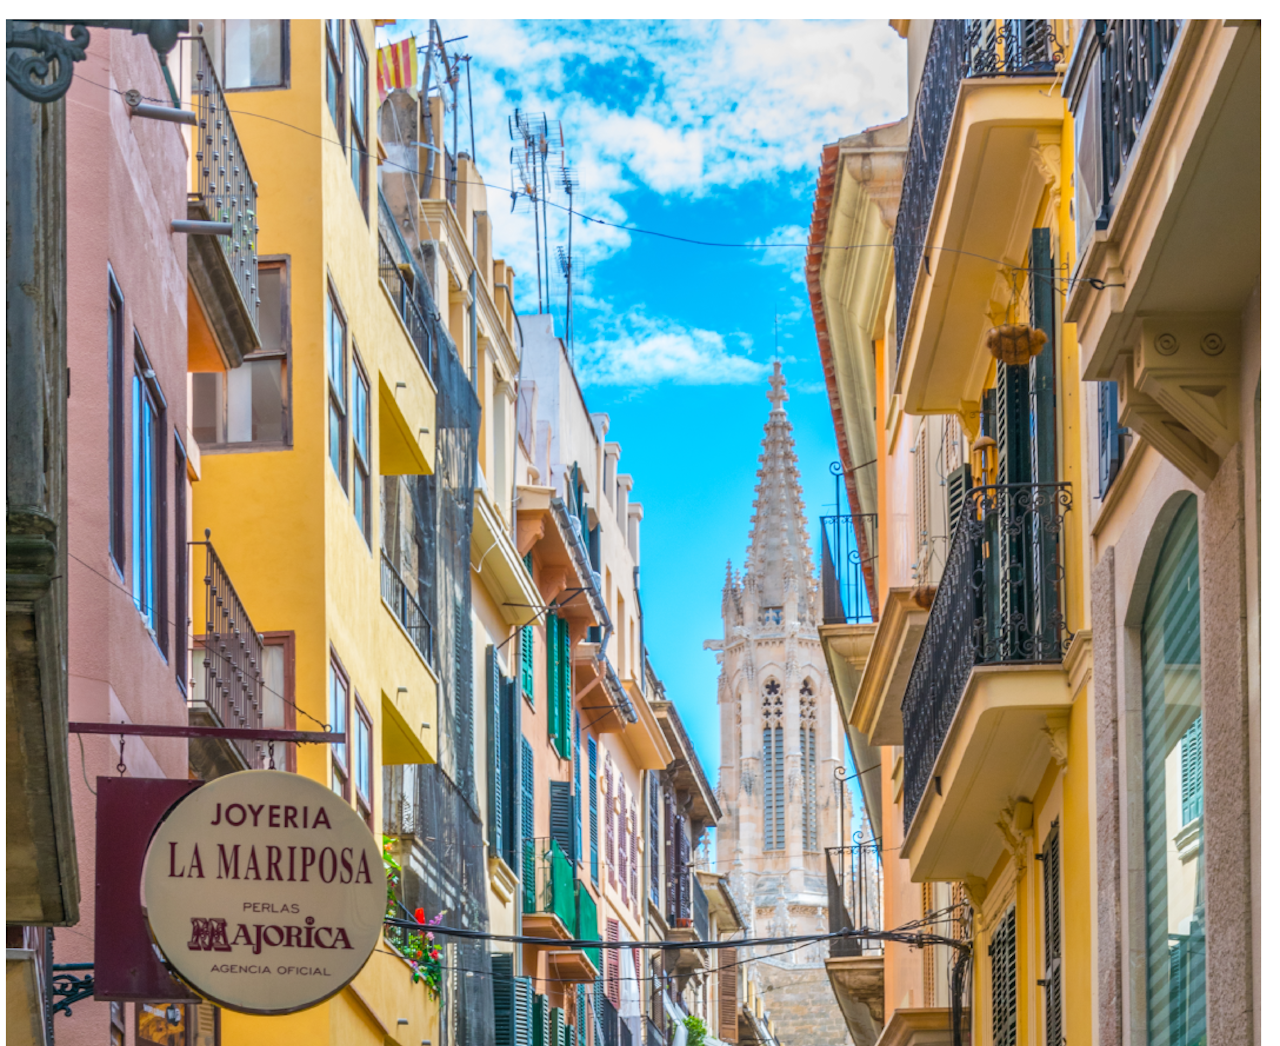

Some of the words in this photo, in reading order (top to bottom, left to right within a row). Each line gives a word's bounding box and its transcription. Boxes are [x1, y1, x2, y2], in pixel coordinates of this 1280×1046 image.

[210, 802, 332, 830] JOYERIA
[167, 841, 206, 879] LA
[216, 843, 373, 885] MARIPOSA
[242, 902, 300, 914] PERLAS
[210, 964, 272, 975] AGENCIA
[277, 965, 332, 977] OFICIAL
